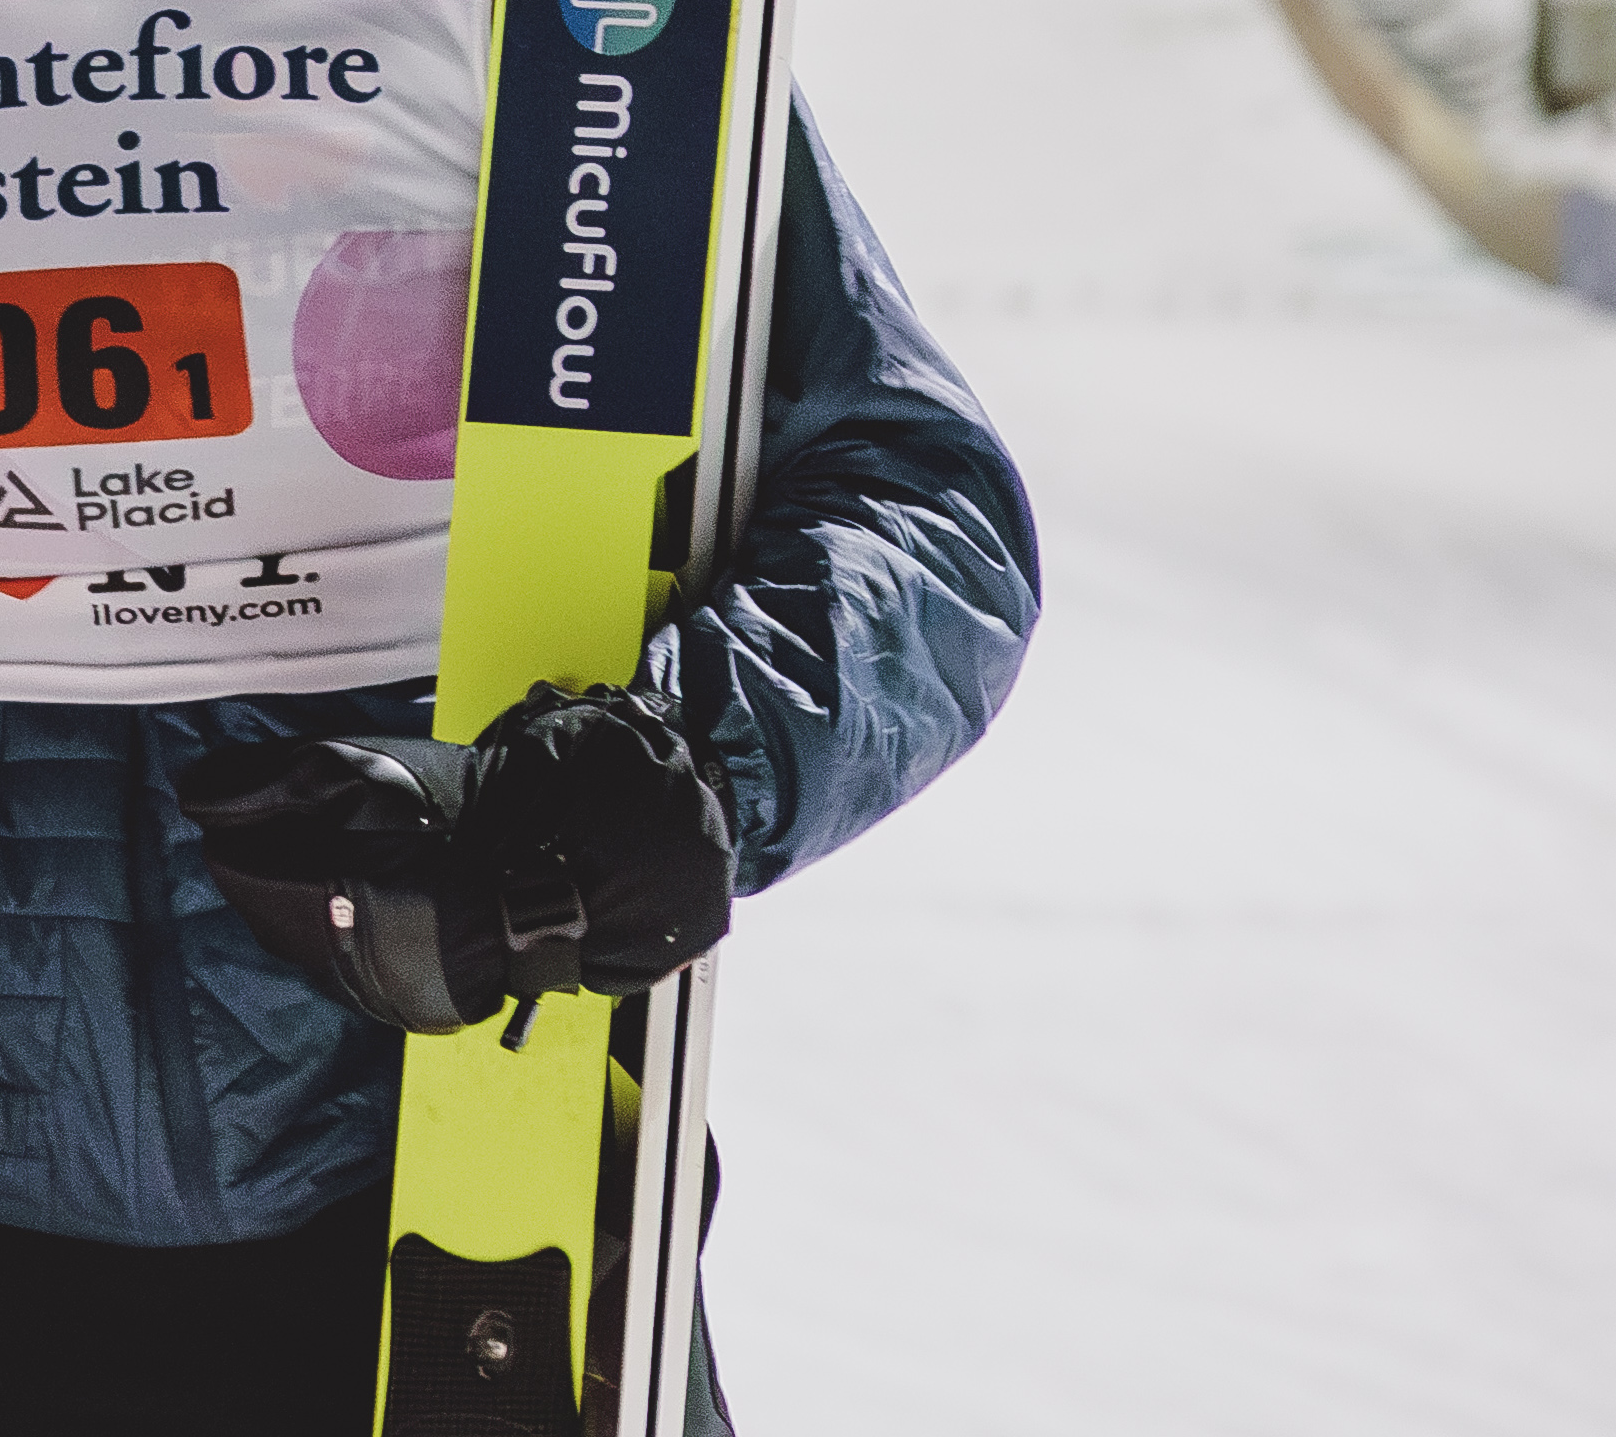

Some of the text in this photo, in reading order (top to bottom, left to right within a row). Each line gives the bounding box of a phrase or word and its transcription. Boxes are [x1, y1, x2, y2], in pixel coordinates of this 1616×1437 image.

[71, 461, 196, 499] Lake
[76, 487, 237, 533] Placid
[91, 594, 323, 627] iloveny.com
